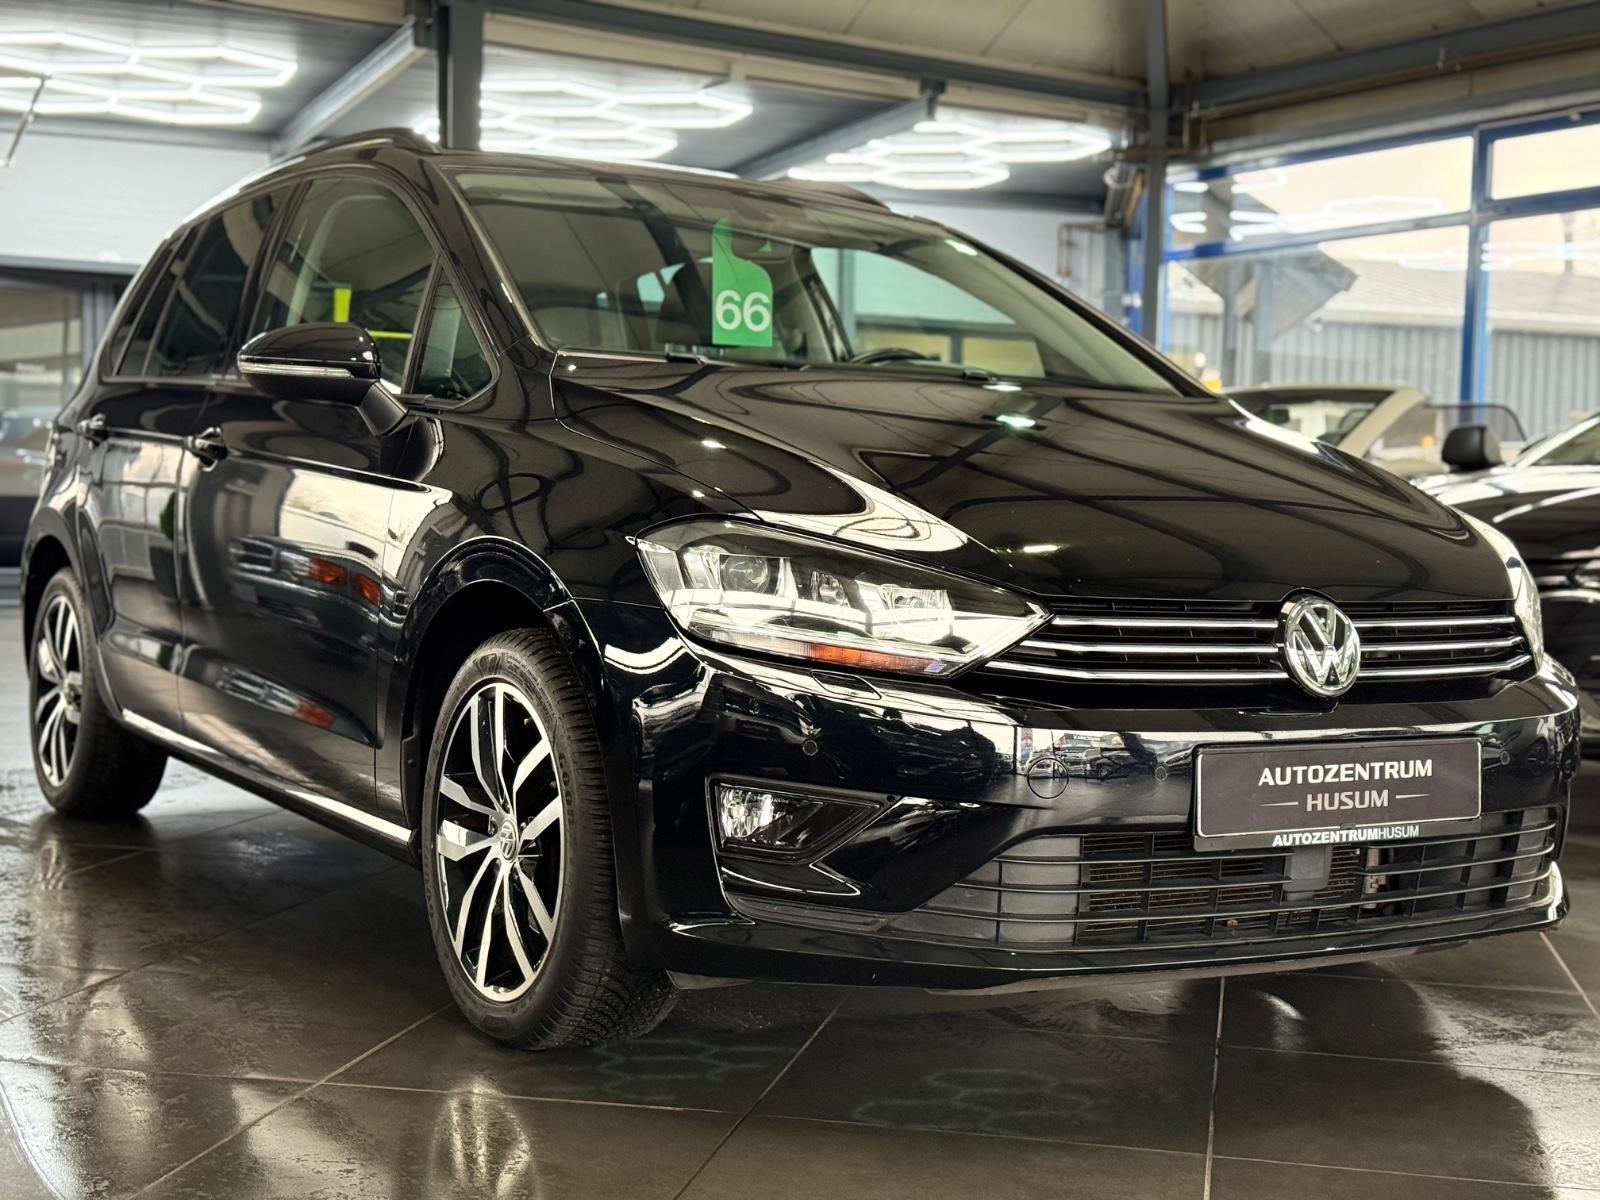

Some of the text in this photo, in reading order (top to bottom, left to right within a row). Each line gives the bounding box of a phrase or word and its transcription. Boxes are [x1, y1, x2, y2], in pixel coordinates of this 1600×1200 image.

[715, 289, 771, 332] 66
[1287, 599, 1357, 692] VW
[1258, 759, 1433, 787] AUTOZENTRUM
[1306, 789, 1389, 812] HUSUM
